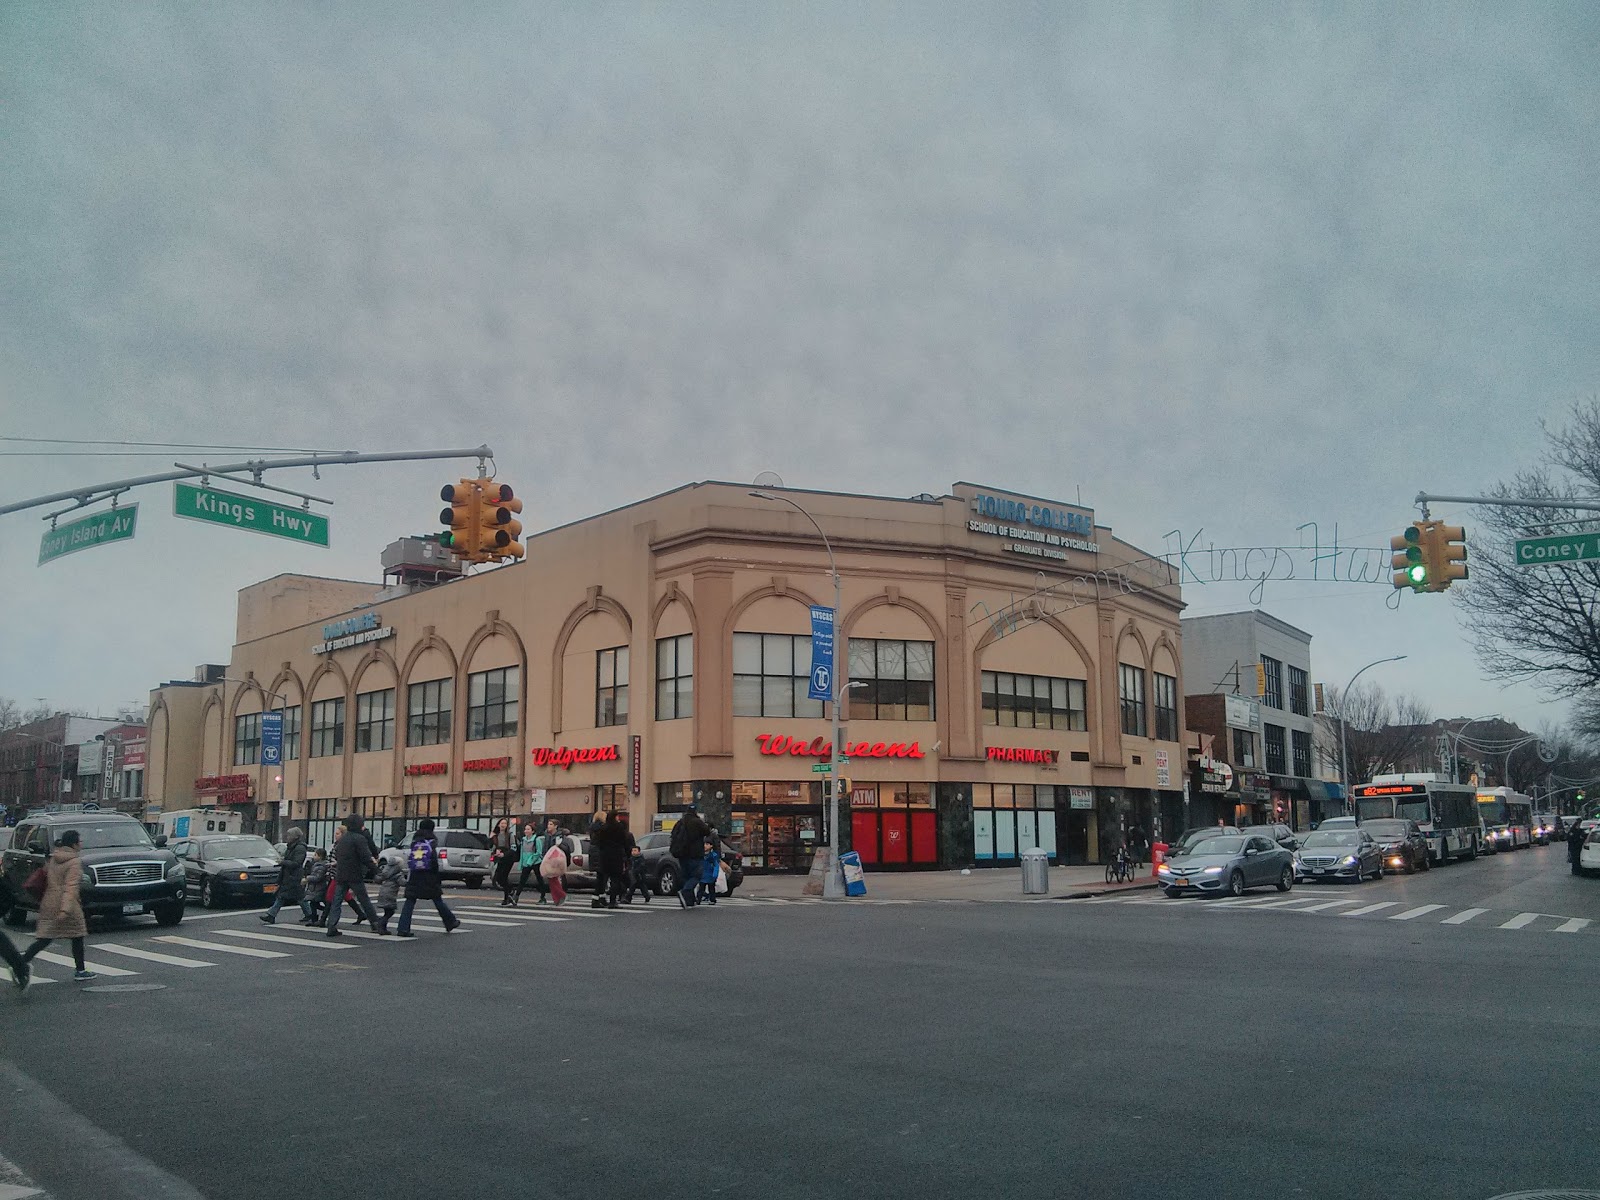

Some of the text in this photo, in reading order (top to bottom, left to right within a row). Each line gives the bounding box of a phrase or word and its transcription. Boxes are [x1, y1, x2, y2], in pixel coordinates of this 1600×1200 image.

[196, 491, 313, 537] Kings Hwy
[1031, 505, 1093, 536] COLLEGE
[71, 520, 106, 545] Island
[111, 516, 131, 533] Av
[969, 520, 1100, 553] SCHOOL OF EDUCATION AND PSYCHOLOGY
[1014, 543, 1042, 557] GRADUATE
[1521, 543, 1585, 559] Coney
[1162, 528, 1295, 605] Kings
[812, 610, 833, 622] NYSCAS
[463, 756, 508, 771] PHARMACY
[532, 744, 617, 770] Walgreens
[986, 747, 1059, 764] PHARMACY
[105, 751, 114, 787] FRAMING
[420, 762, 446, 775] PHOTO
[853, 790, 874, 804] ATM
[1071, 789, 1091, 797] RENT
